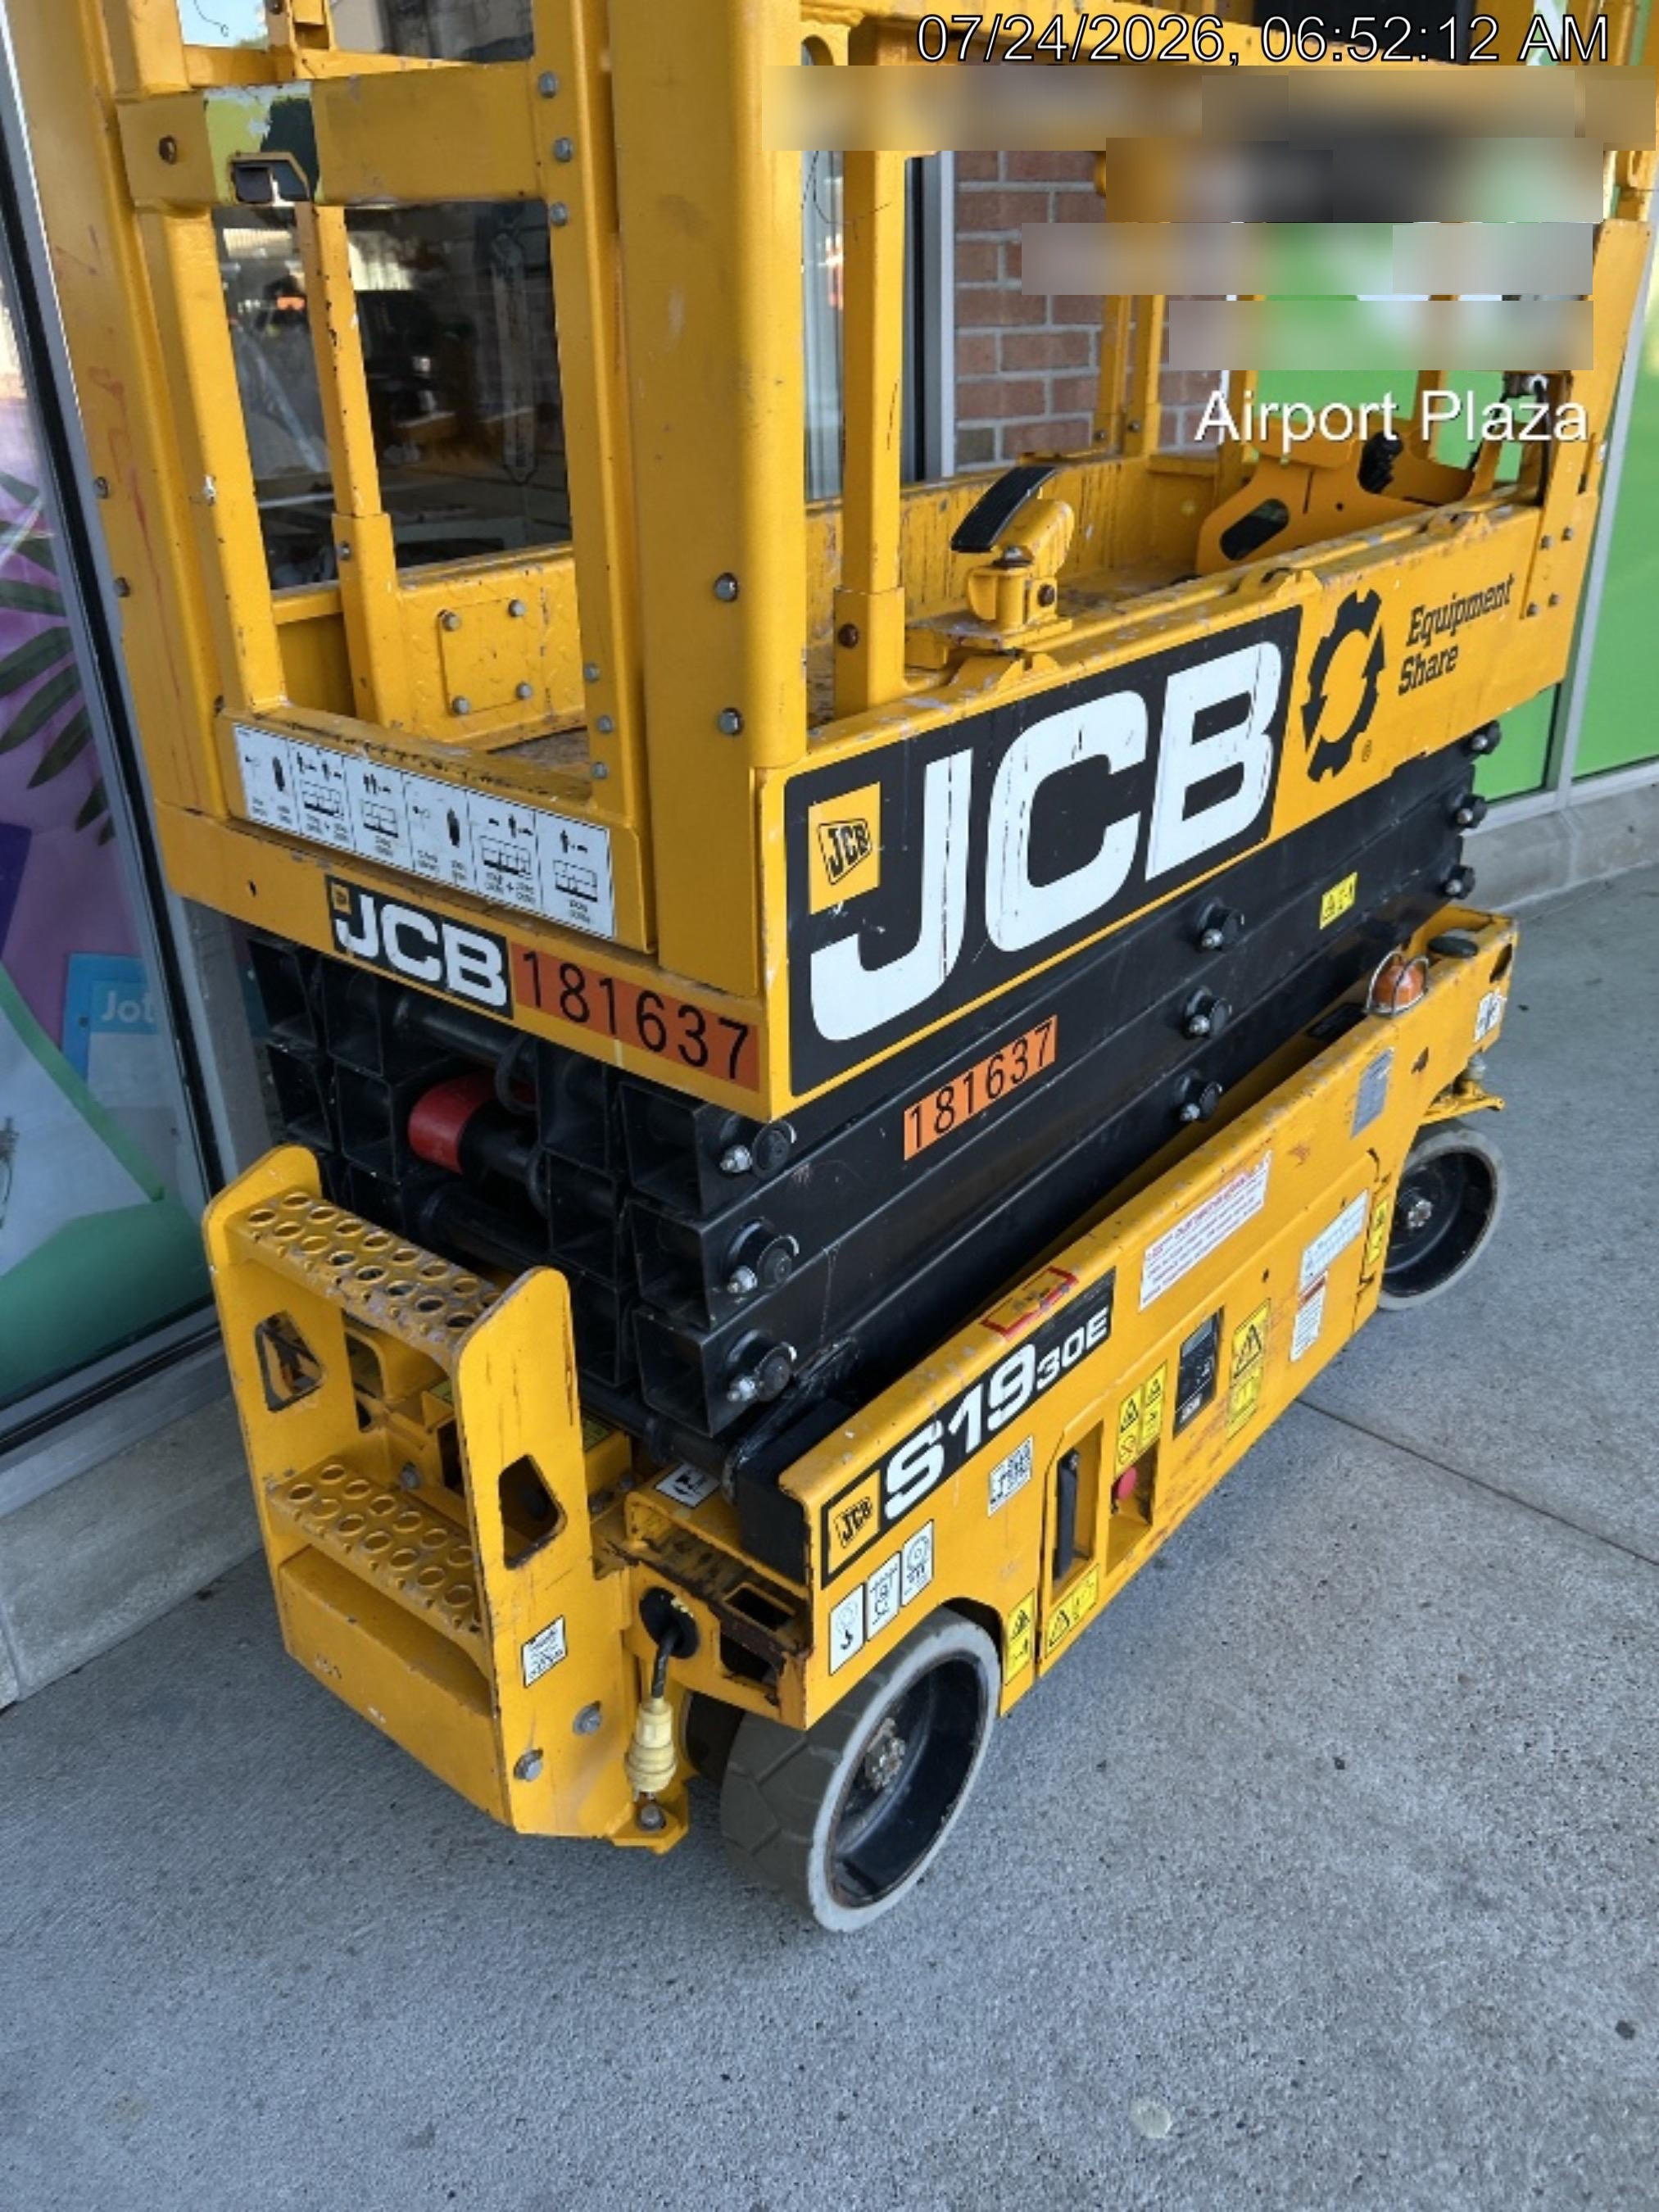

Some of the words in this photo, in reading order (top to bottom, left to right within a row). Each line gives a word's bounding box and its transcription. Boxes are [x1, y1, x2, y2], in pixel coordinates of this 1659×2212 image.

[1406, 572, 1515, 649] Equipment
[1398, 646, 1459, 696] Share
[809, 641, 1283, 1042] JCB
[826, 819, 870, 878] JCB
[334, 893, 507, 1008] JCB
[522, 950, 750, 1081] 181637
[909, 1022, 1053, 1149] 181637
